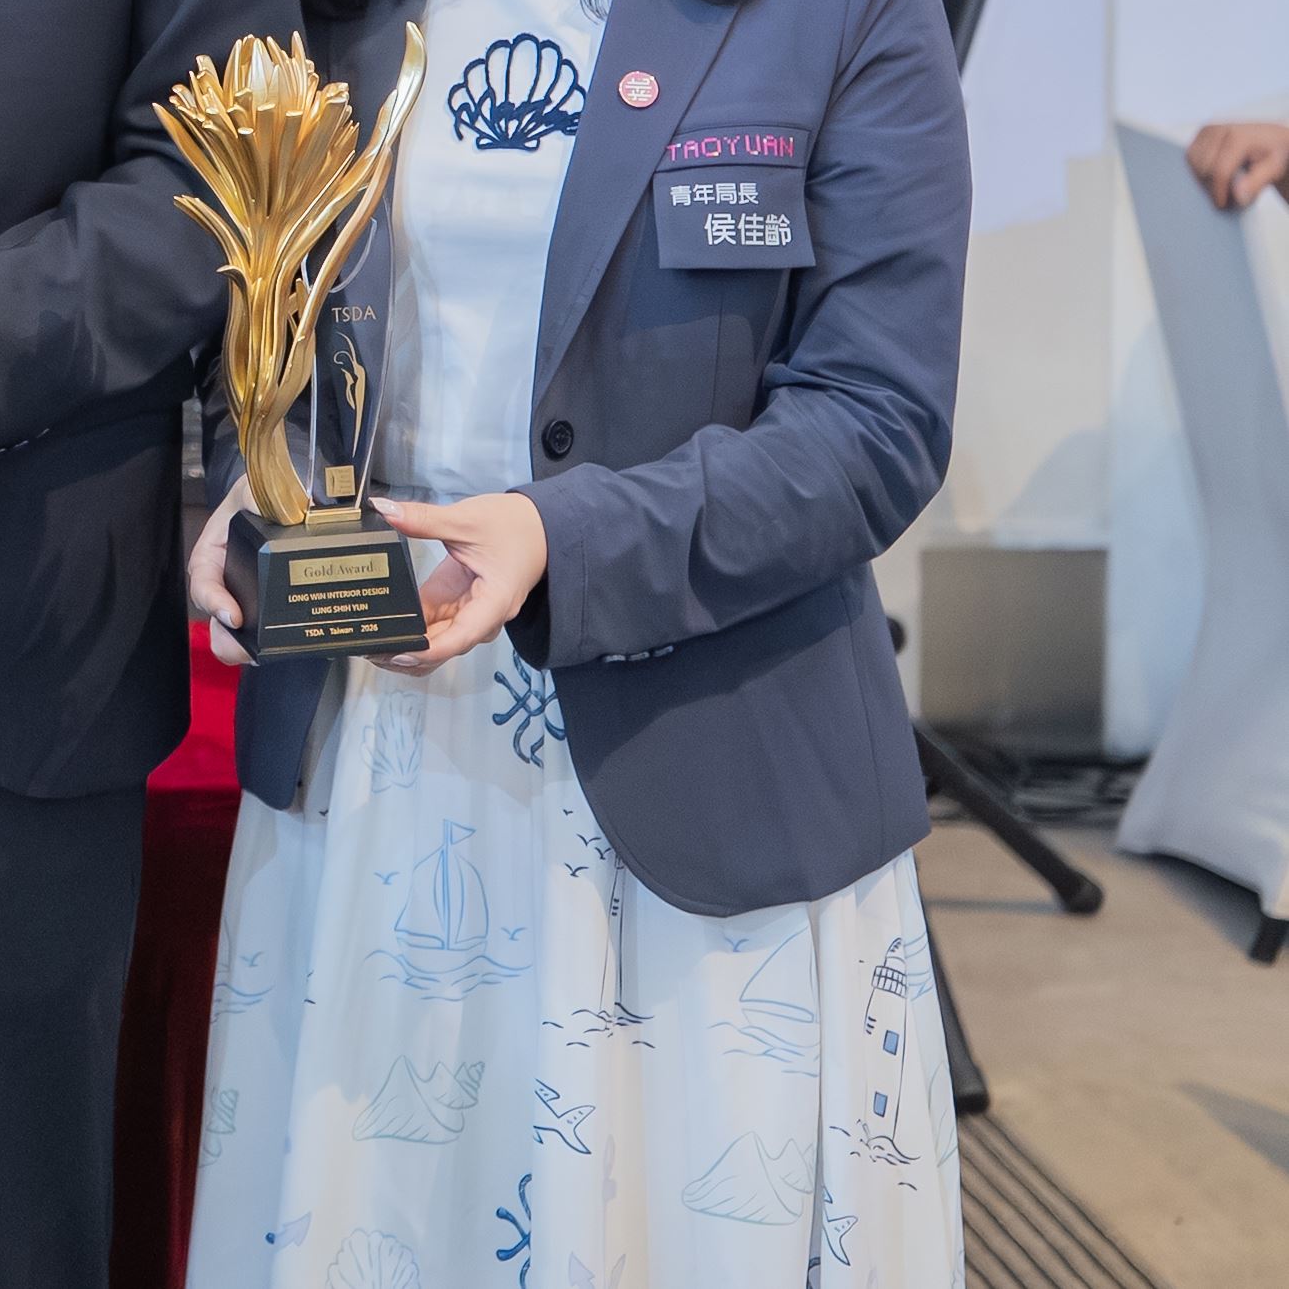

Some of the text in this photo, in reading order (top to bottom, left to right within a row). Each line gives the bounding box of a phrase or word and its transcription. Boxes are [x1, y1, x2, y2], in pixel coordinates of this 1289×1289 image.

[666, 134, 795, 162] TAOYUAN
[670, 182, 759, 207] 青年局長
[704, 213, 792, 247] 侯佳齡
[331, 306, 377, 324] TSDA
[304, 561, 374, 578] Gold Award
[288, 586, 390, 603] LONG WIN INTERIOR DESIGN
[312, 606, 332, 615] LUNG
[352, 603, 369, 612] YUN
[304, 628, 325, 638] TSDA
[329, 626, 354, 636] Taiwan
